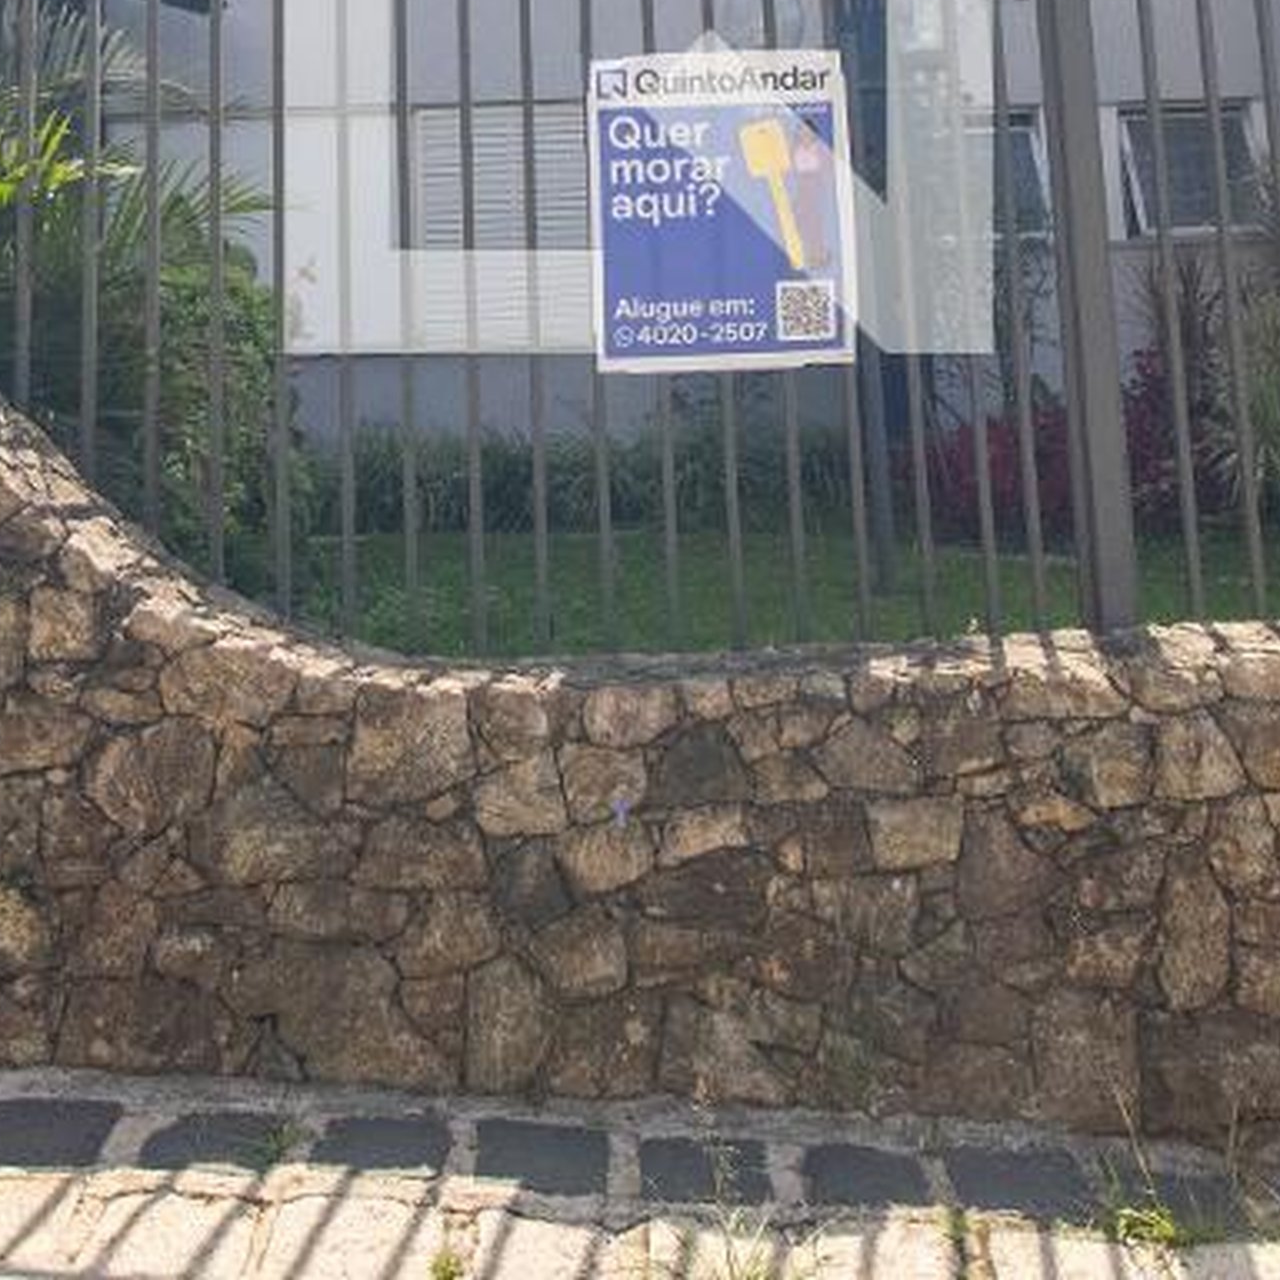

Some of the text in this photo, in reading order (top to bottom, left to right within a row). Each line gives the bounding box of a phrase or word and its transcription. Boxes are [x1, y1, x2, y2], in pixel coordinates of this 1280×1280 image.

[634, 66, 830, 95] QuintoAndar
[609, 116, 710, 149] Quer
[610, 156, 728, 184] morar
[612, 184, 720, 226] aqui?
[614, 298, 755, 323] Alugue em:
